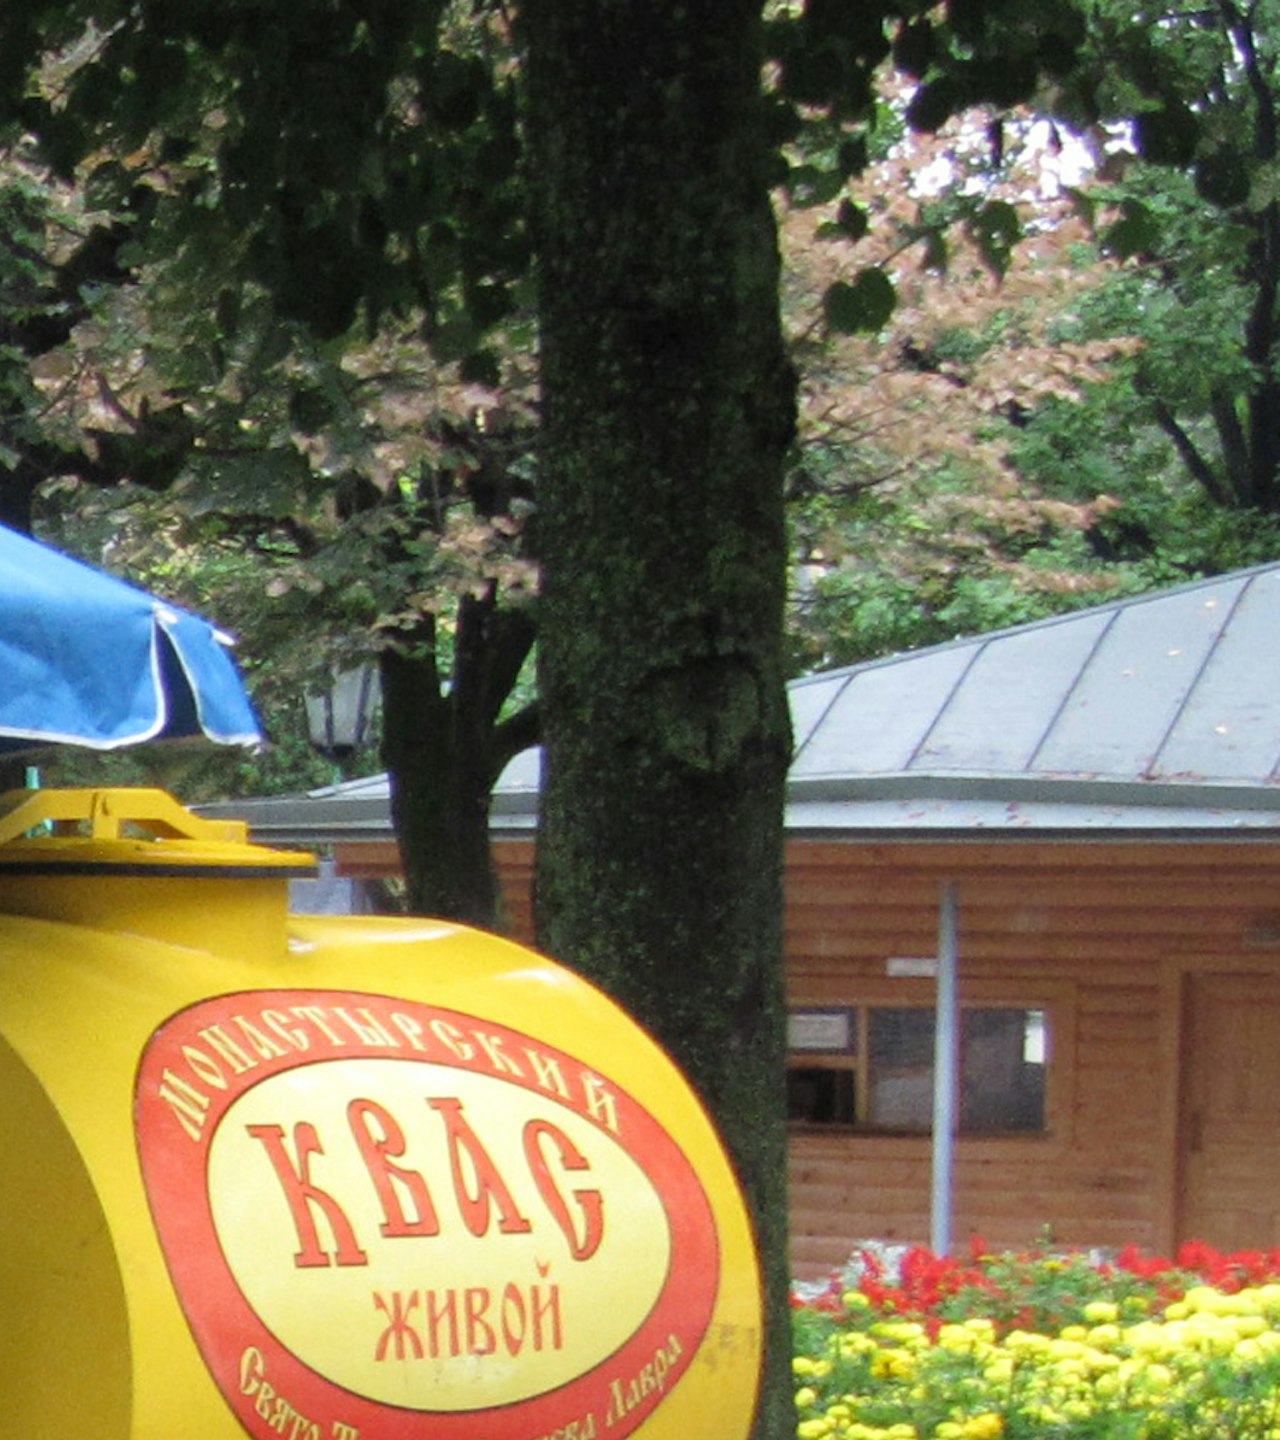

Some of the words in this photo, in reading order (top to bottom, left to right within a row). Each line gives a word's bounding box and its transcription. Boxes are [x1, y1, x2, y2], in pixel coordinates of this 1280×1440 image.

[158, 1005, 622, 1142] МОНАСТЫРСКИЙ
[245, 1096, 604, 1268] КВАС
[372, 1257, 564, 1362] ЖИВОЙ
[605, 1335, 683, 1428] Лавра
